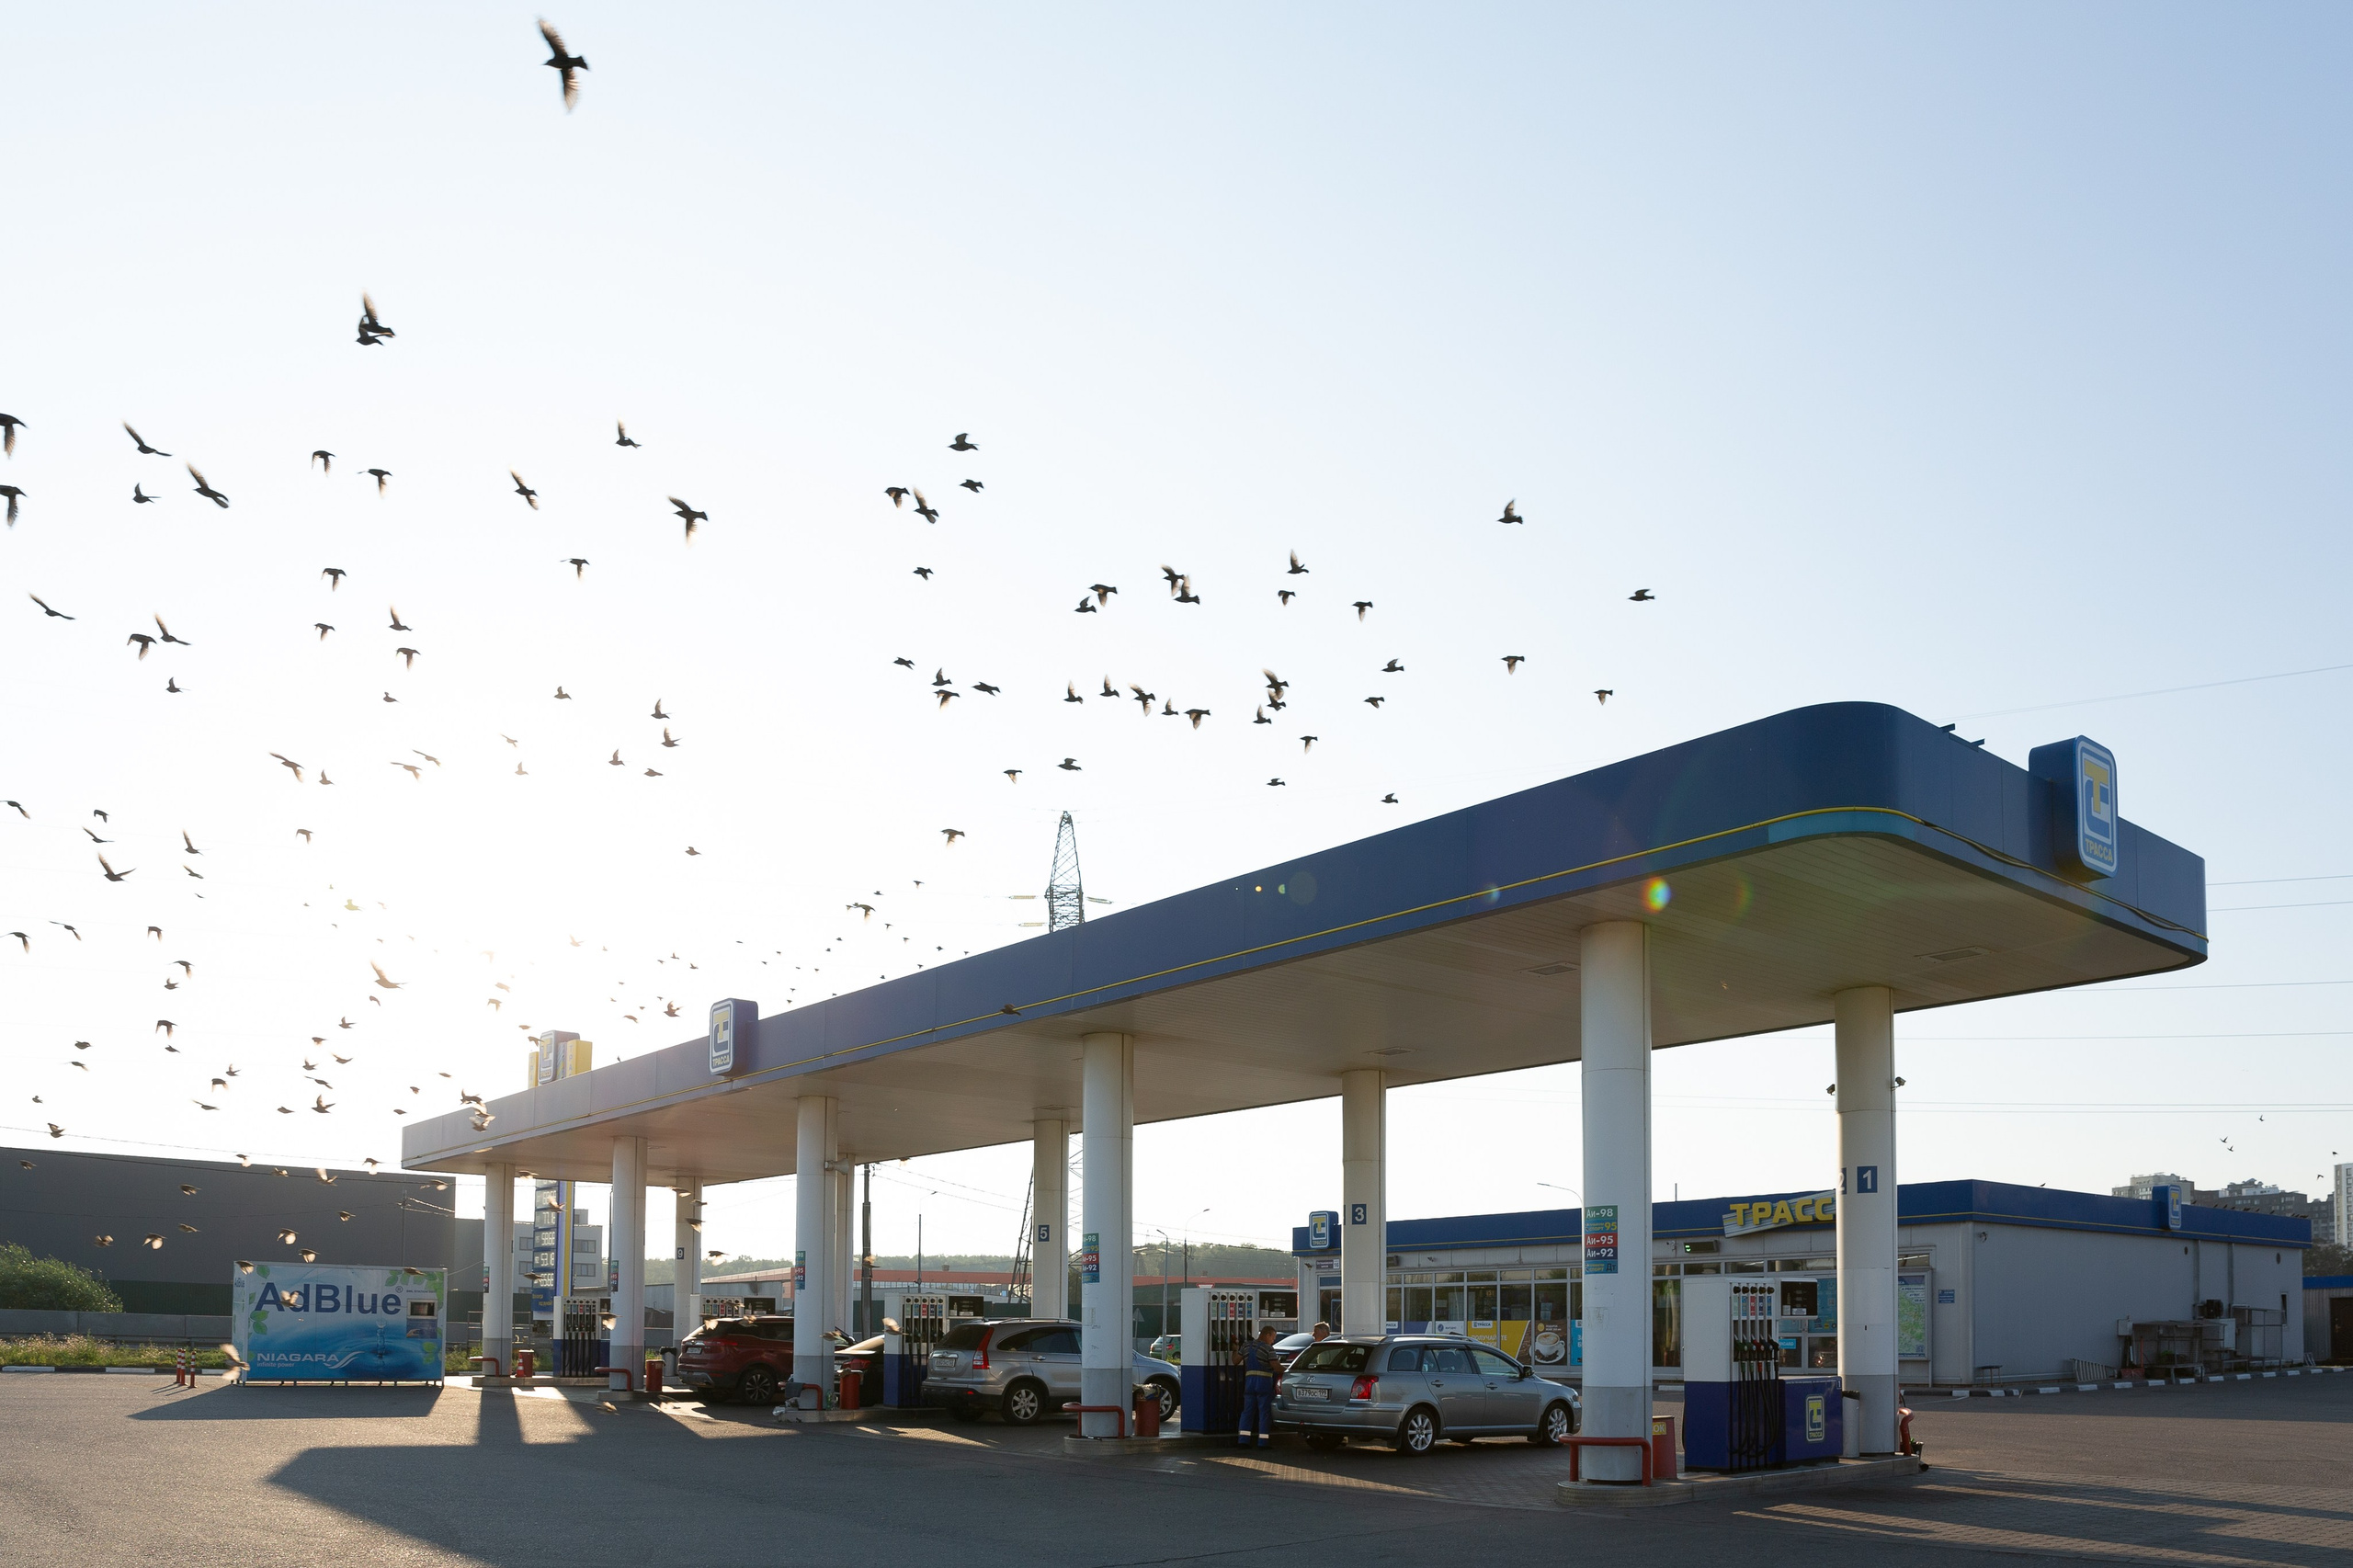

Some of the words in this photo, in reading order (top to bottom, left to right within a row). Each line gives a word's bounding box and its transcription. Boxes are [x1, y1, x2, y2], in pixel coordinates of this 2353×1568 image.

[2084, 837, 2114, 864] ТРАССА
[712, 1053, 731, 1067] ТРАССА
[1862, 1169, 1872, 1189] 1
[1355, 1207, 1365, 1221] 3
[1586, 1208, 1613, 1219] Аи-98
[1729, 1197, 1835, 1227] ТРАСС
[1604, 1221, 1618, 1231] 95
[1040, 1227, 1048, 1239] 5
[1586, 1235, 1613, 1245] Аи-95
[677, 1248, 684, 1259] 9
[1586, 1247, 1613, 1257] Аи-92
[254, 1281, 402, 1315] AdBlue
[256, 1353, 339, 1362] NIAGARA
